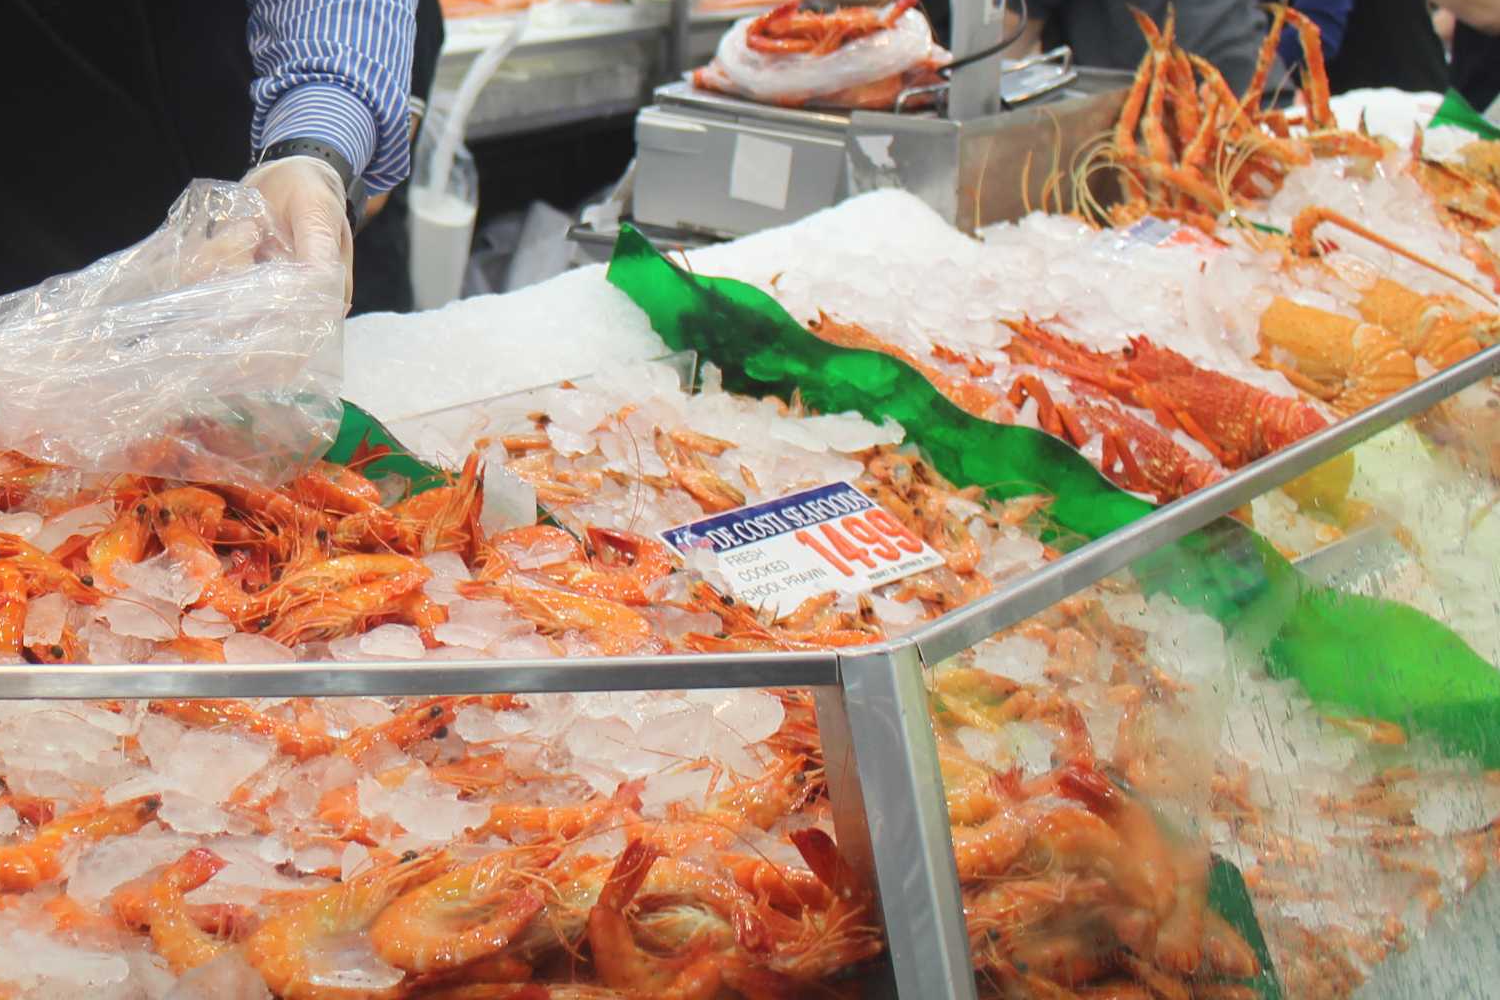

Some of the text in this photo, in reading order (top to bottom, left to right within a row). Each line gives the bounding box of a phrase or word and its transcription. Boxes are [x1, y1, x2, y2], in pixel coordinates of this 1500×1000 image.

[706, 490, 870, 549] DE COSTI SEAFOODS
[796, 509, 925, 577] 1499
[724, 548, 766, 567] FRESH
[738, 560, 791, 583] COOKED
[782, 567, 829, 587] PRAWN
